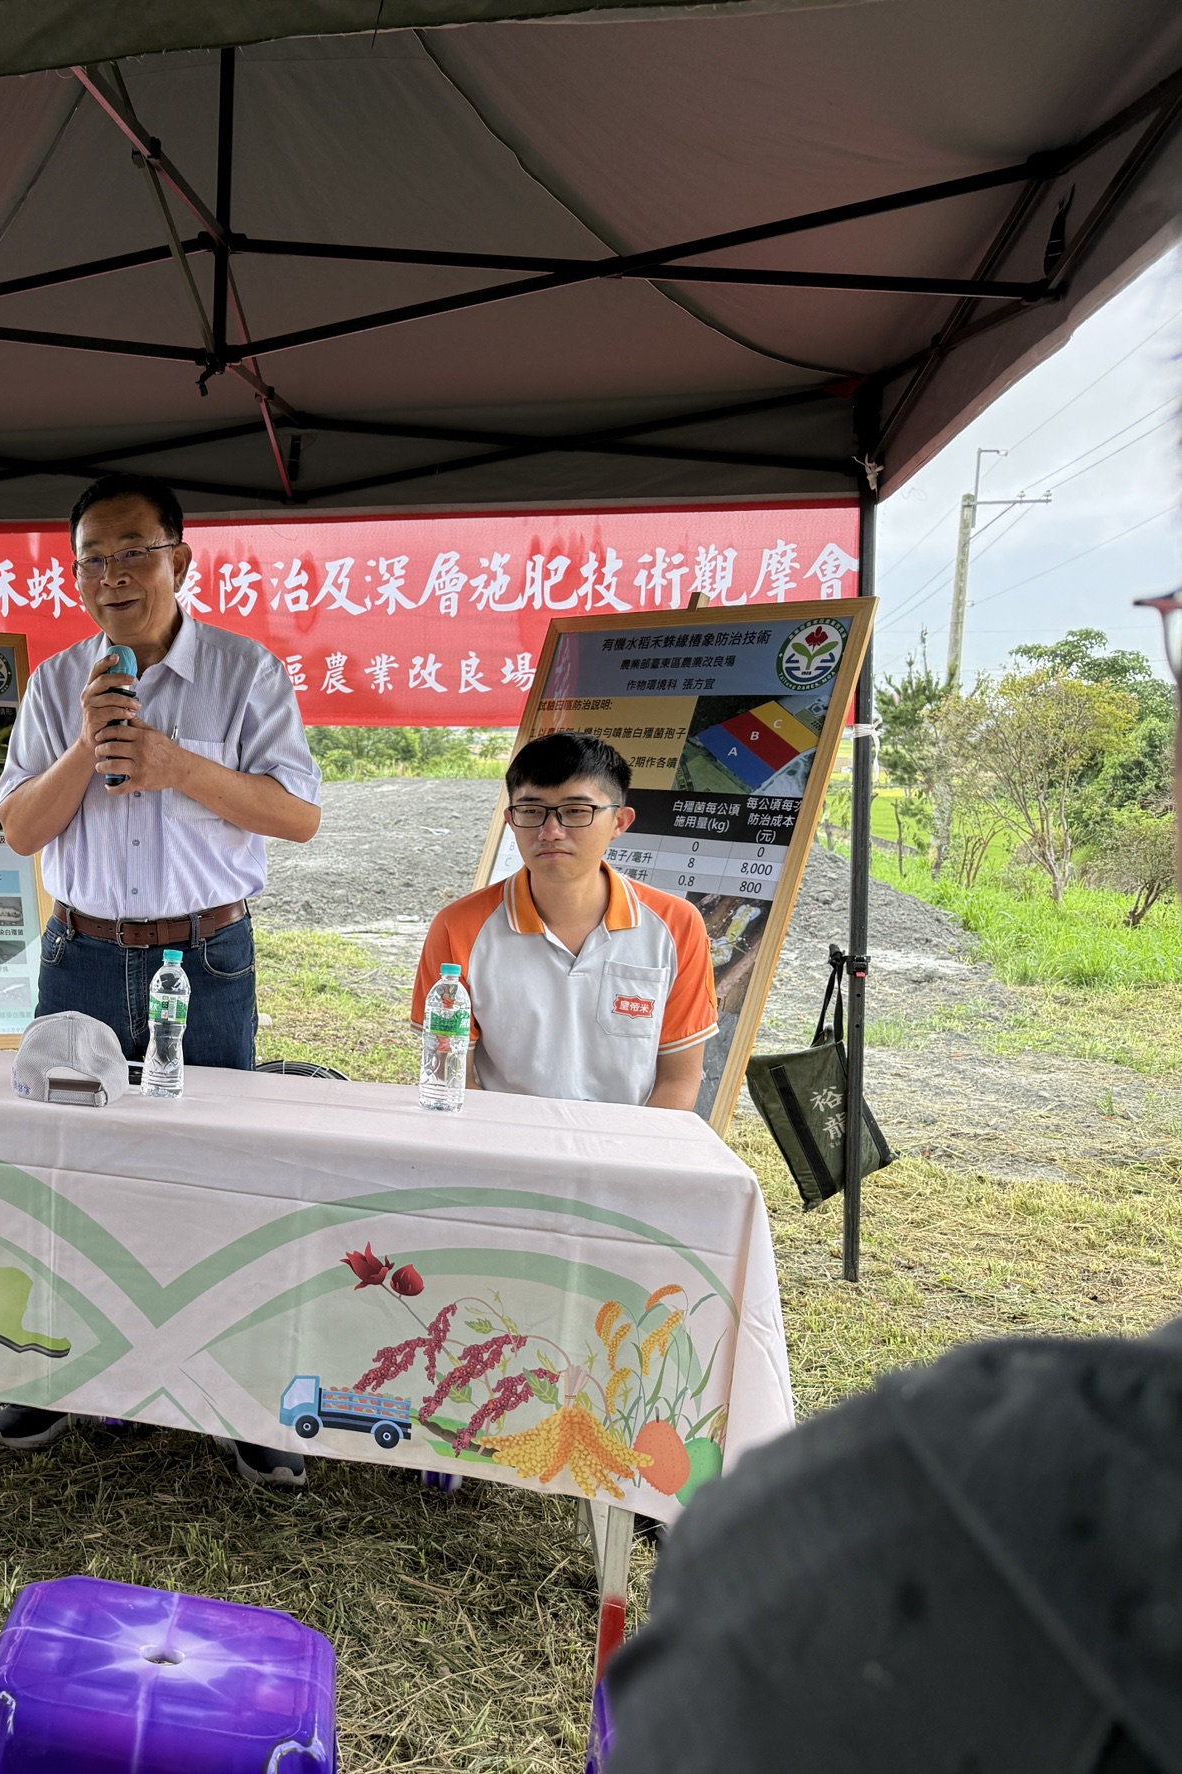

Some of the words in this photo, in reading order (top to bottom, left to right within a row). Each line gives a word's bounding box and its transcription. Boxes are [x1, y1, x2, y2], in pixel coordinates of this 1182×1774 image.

[601, 629, 772, 652] 有機水稻禾蛛緣椿象防治技術
[619, 655, 736, 670] 農業部臺東區農業改良場
[626, 678, 677, 692] 作物環境科
[682, 678, 716, 690] 張方宜
[773, 719, 783, 728] C
[750, 731, 760, 741] B
[727, 747, 738, 757] A
[672, 800, 741, 817] 白殭菌每公頃
[674, 815, 730, 833] 施用量(kg)
[747, 813, 796, 828] 防治成本
[755, 829, 776, 844] (元)
[691, 841, 699, 852] 0
[757, 847, 765, 858] 0
[687, 857, 695, 868] 8
[740, 862, 773, 876] 8,000
[678, 874, 695, 887] 0.8
[739, 881, 762, 894] 800
[619, 1001, 649, 1013] 皇帝米
